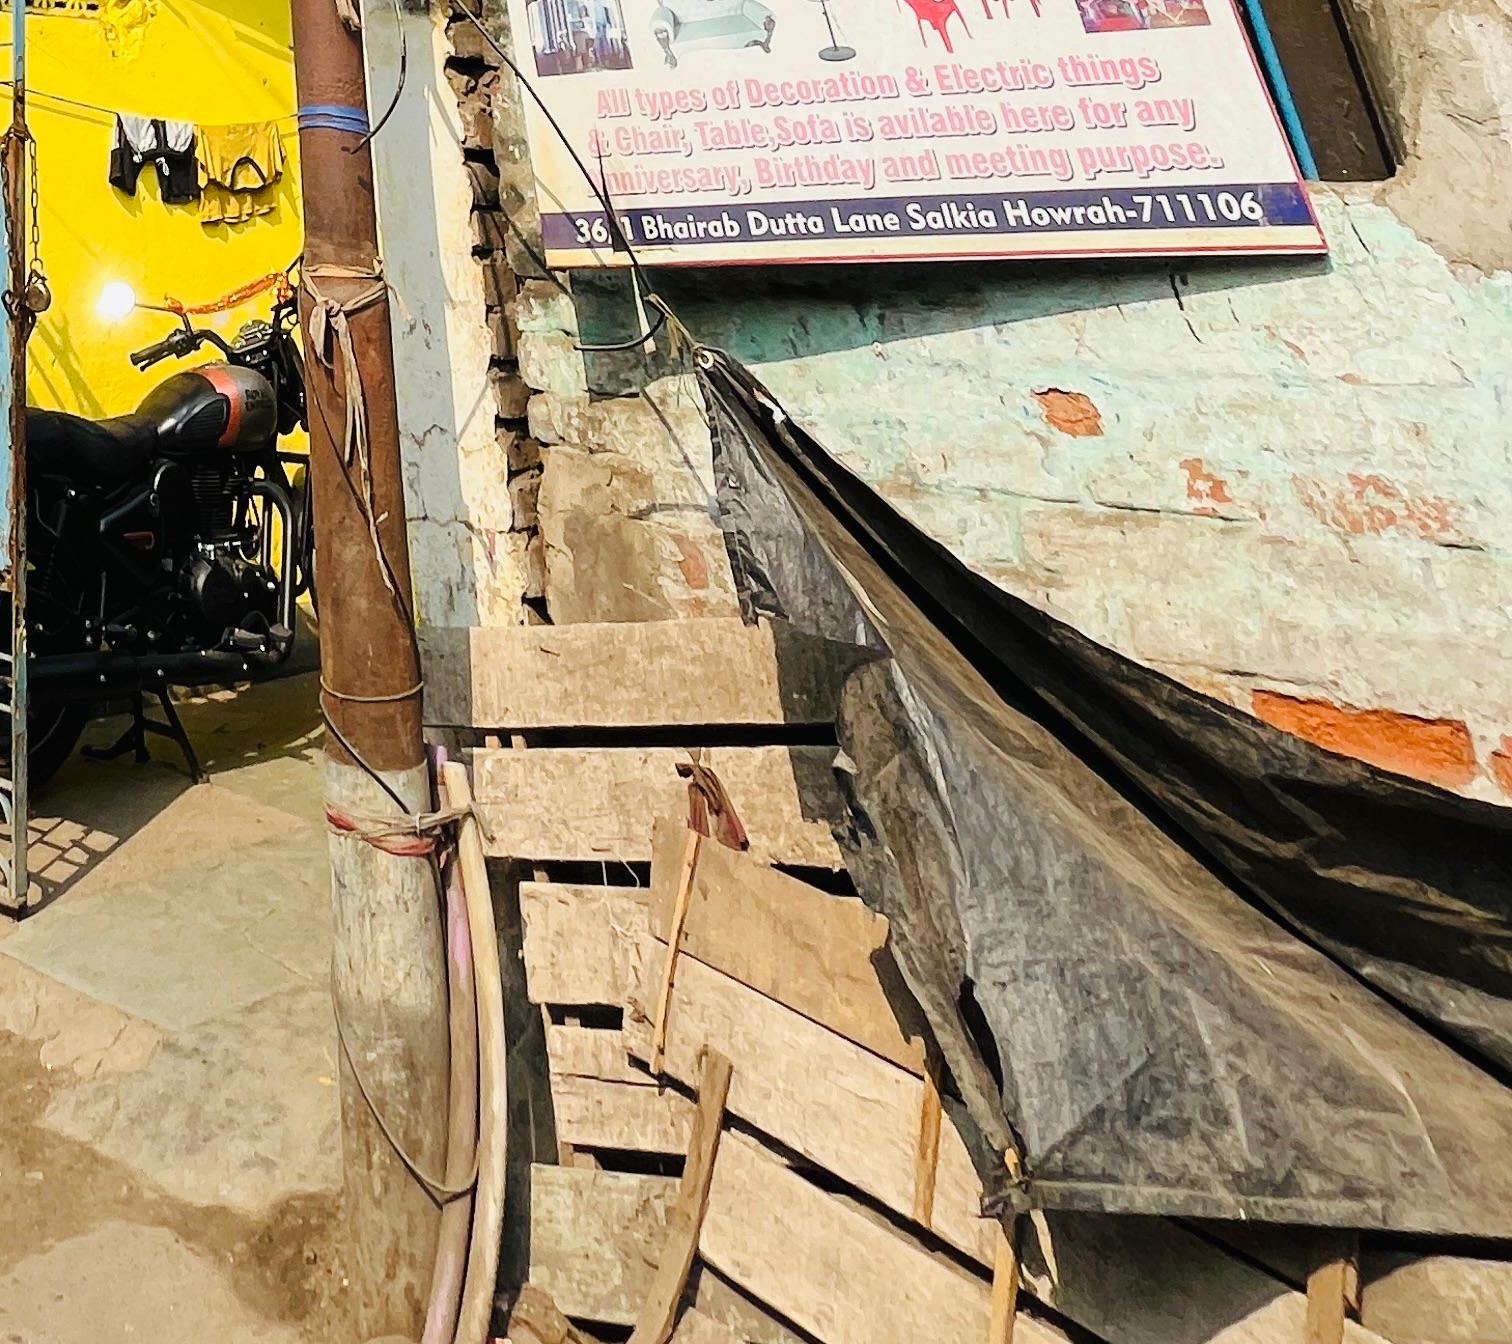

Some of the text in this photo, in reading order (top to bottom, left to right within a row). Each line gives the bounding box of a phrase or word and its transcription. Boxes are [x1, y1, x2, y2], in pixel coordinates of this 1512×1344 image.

[596, 54, 1161, 120] All types of Decoration & Electric things
[587, 128, 612, 157] &
[614, 125, 692, 156] Chair,
[844, 111, 874, 141] is
[878, 104, 997, 140] avilable
[999, 100, 1075, 134] here
[1077, 96, 1128, 129] for
[1133, 95, 1197, 131] any
[754, 156, 876, 189] Birthday
[882, 149, 941, 182] and
[944, 144, 1074, 181] meeting
[1076, 139, 1224, 181] purpose.
[575, 191, 1264, 245] 361 Bhairab Dutta Lane Salkia Howrah-711106
